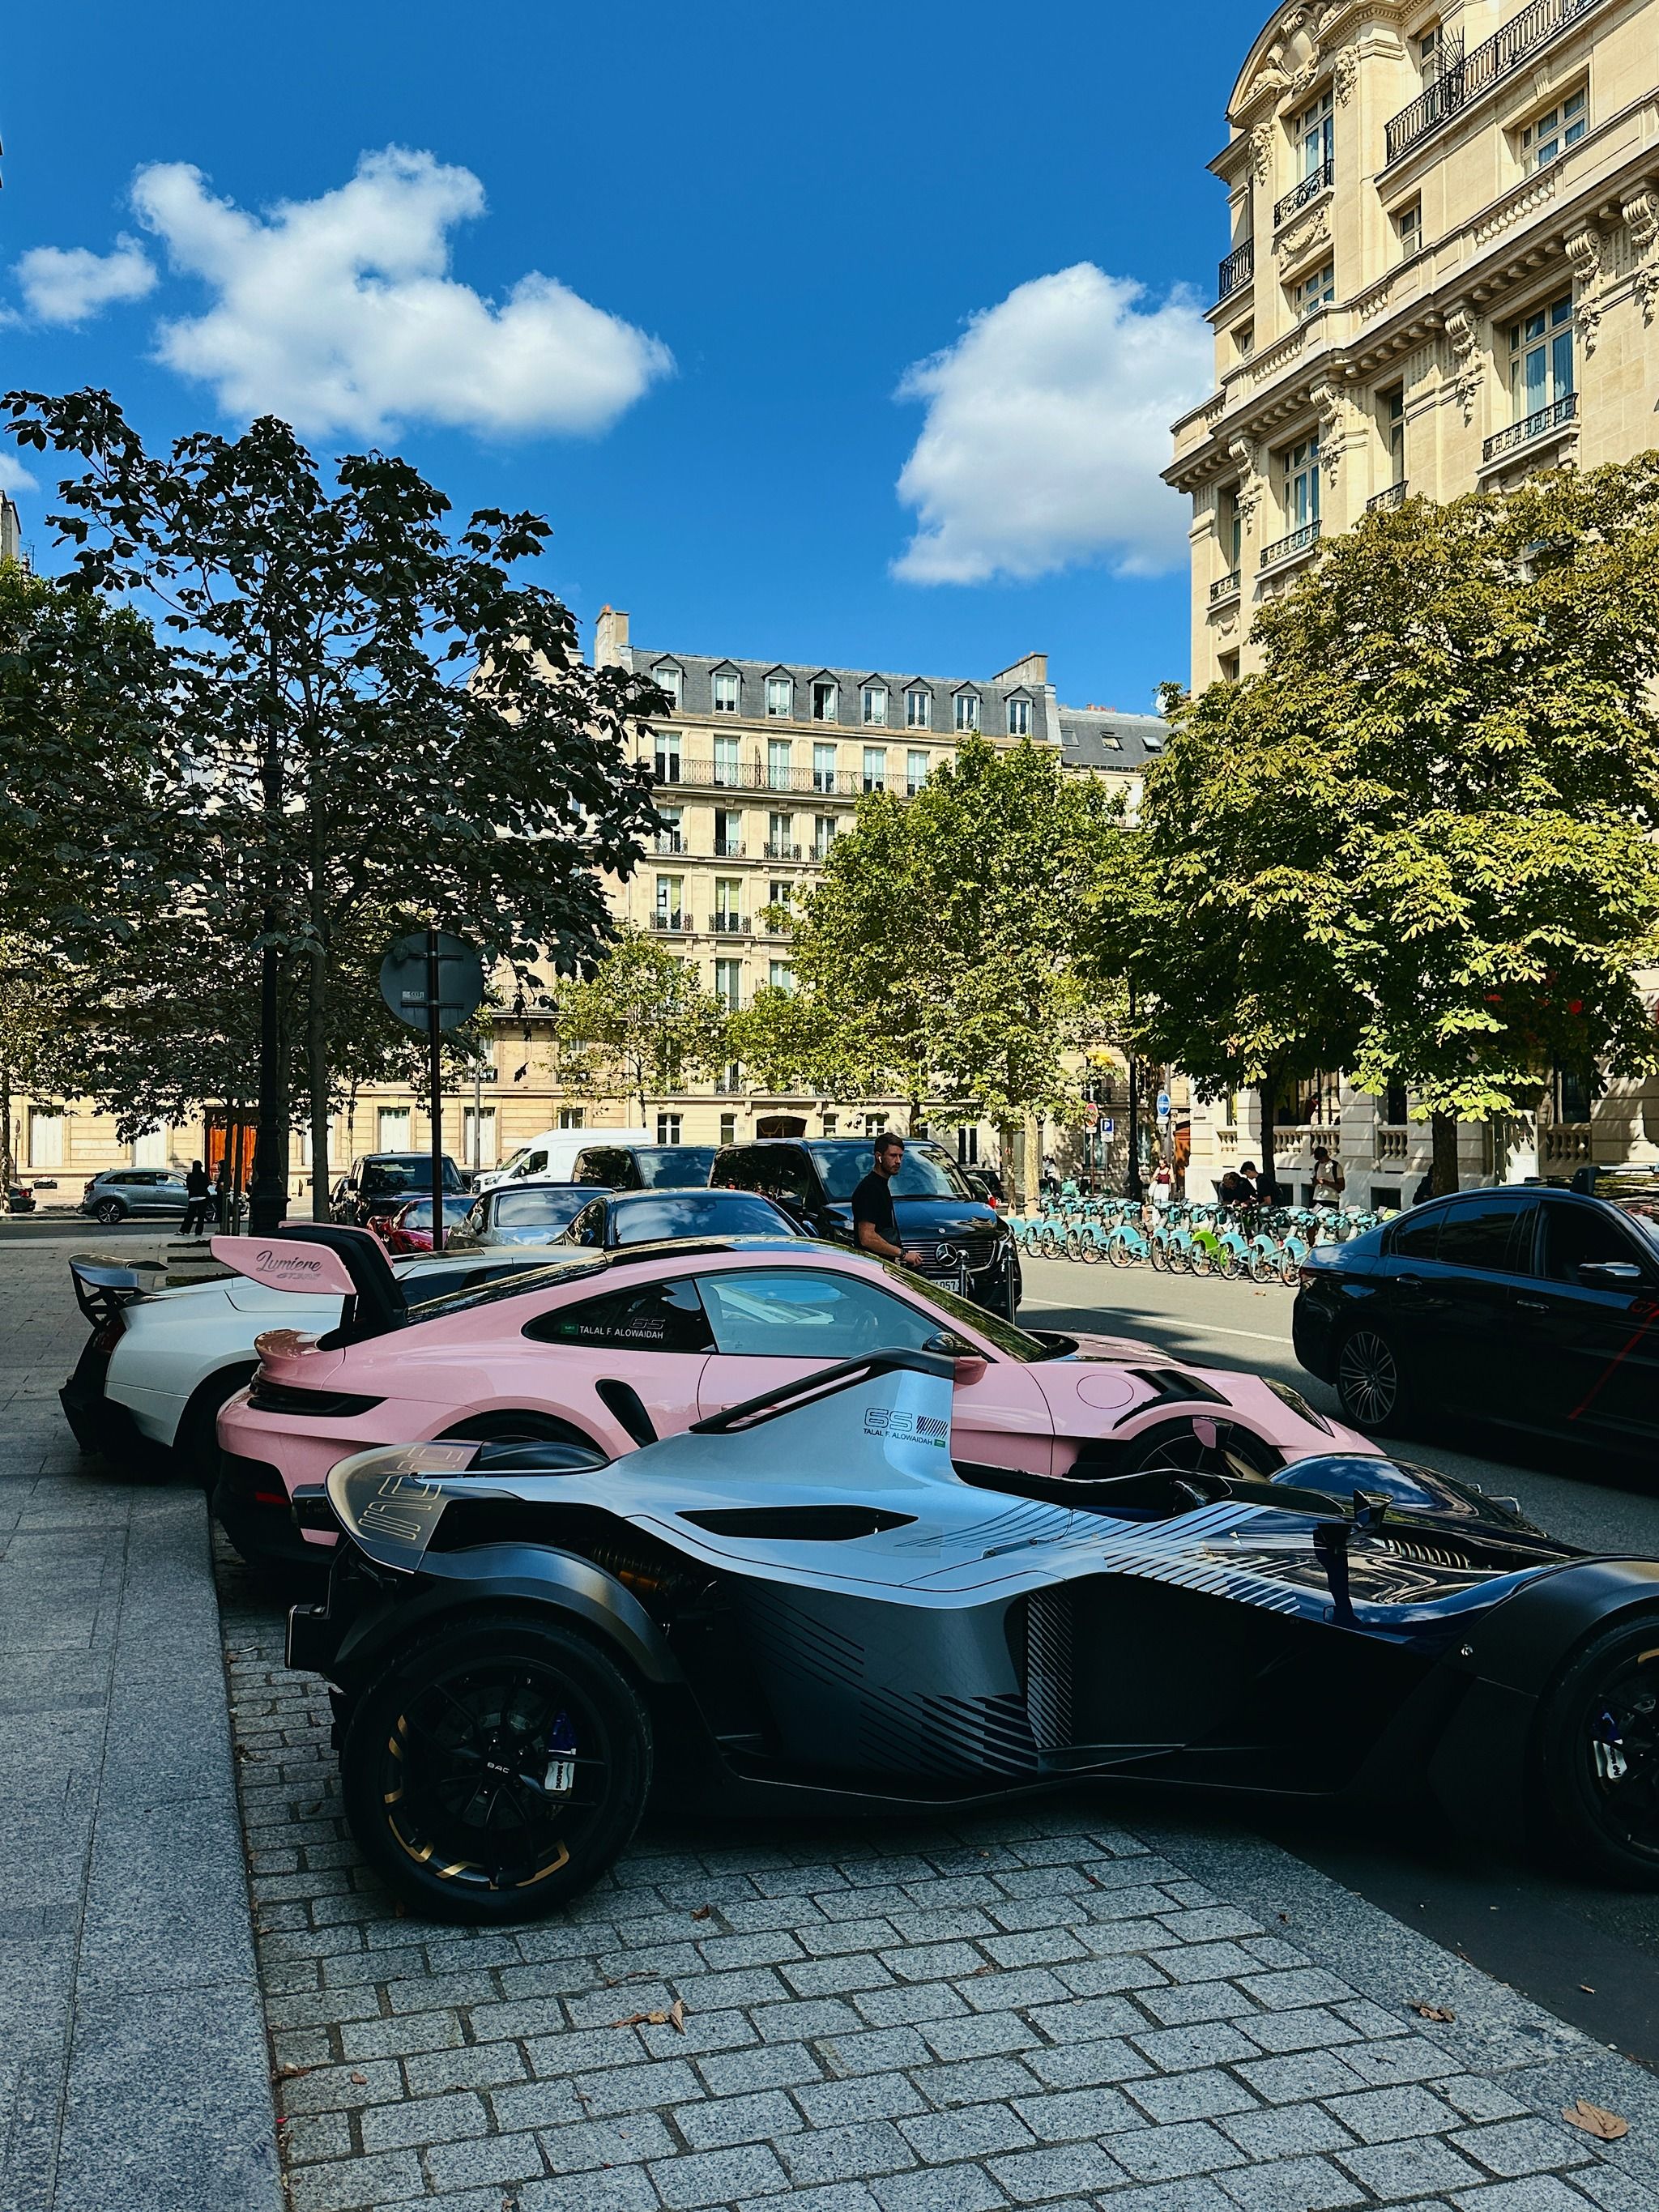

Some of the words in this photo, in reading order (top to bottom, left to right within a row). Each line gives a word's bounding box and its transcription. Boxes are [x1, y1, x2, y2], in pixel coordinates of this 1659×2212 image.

[1103, 1121, 1111, 1131] P
[579, 1325, 604, 1336] TALAL
[614, 1328, 664, 1340] ALOWAIDAH
[863, 1427, 884, 1437] TALAL
[891, 1432, 933, 1446] ALOWAIDAH
[487, 1762, 510, 1774] BAC
